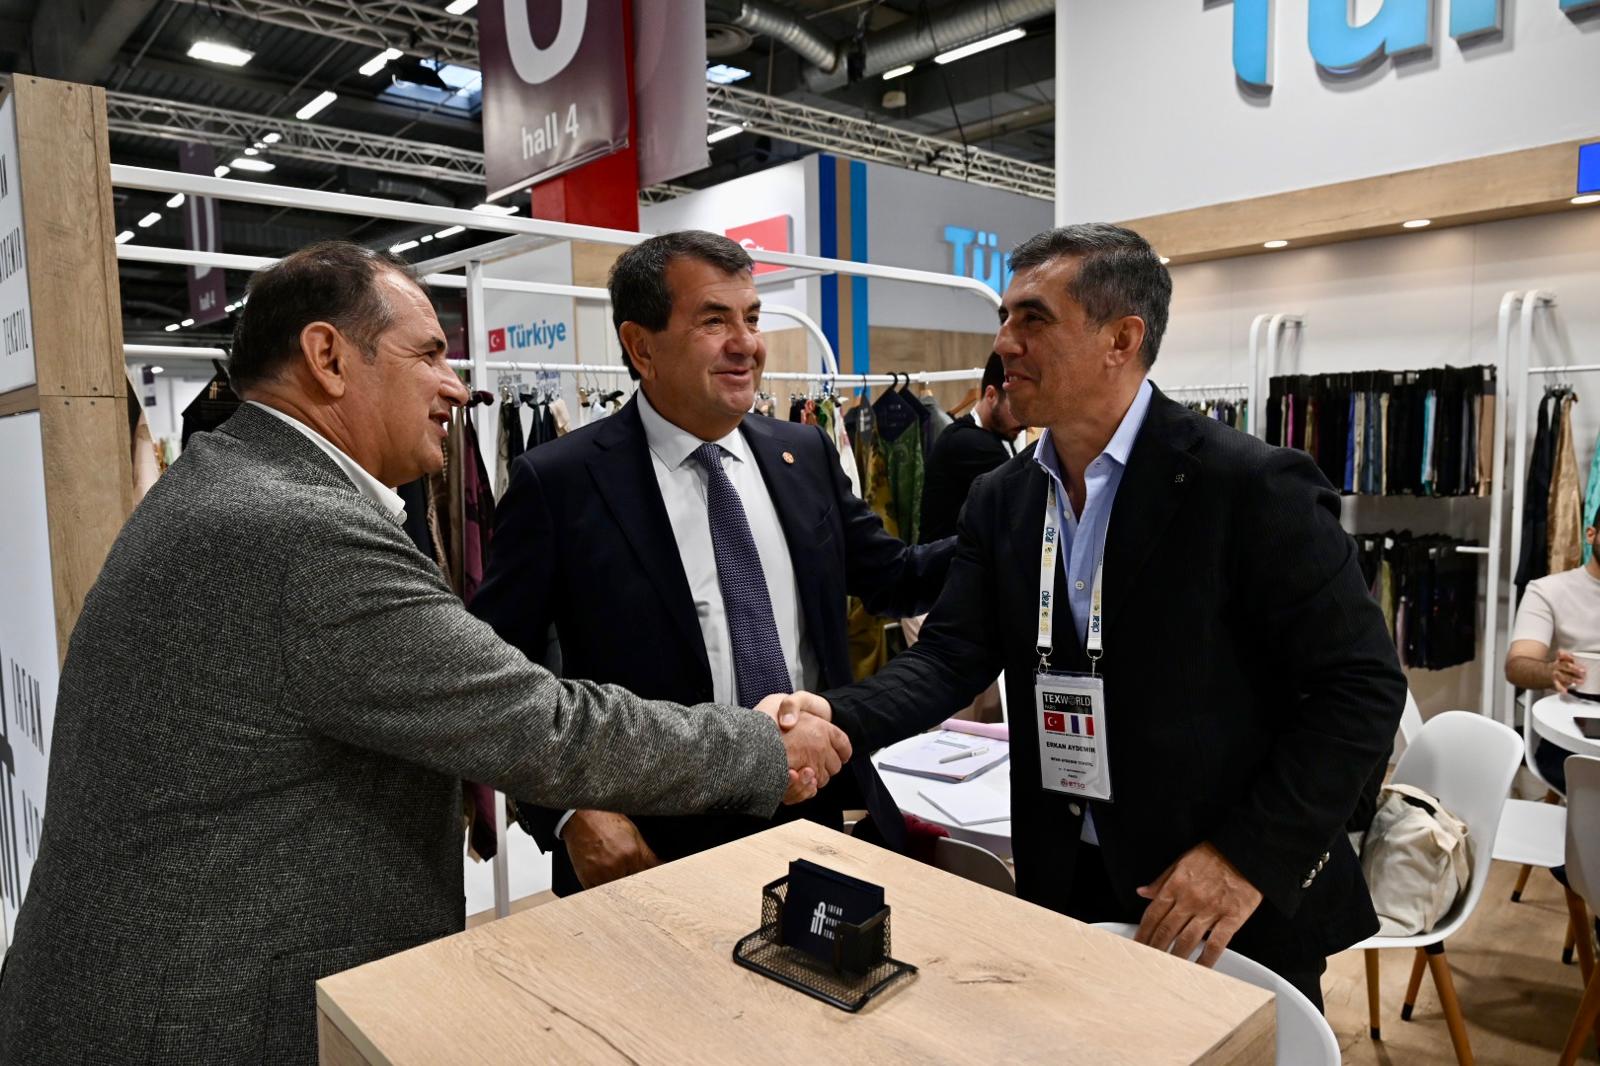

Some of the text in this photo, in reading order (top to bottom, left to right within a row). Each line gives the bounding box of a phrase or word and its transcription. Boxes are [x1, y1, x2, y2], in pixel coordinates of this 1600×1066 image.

[521, 103, 579, 160] hall 4
[507, 320, 566, 350] Türkiye
[1045, 527, 1056, 544] clear
[1041, 591, 1052, 608] clear
[1091, 615, 1100, 633] clear
[1046, 741, 1067, 750] ERKAN
